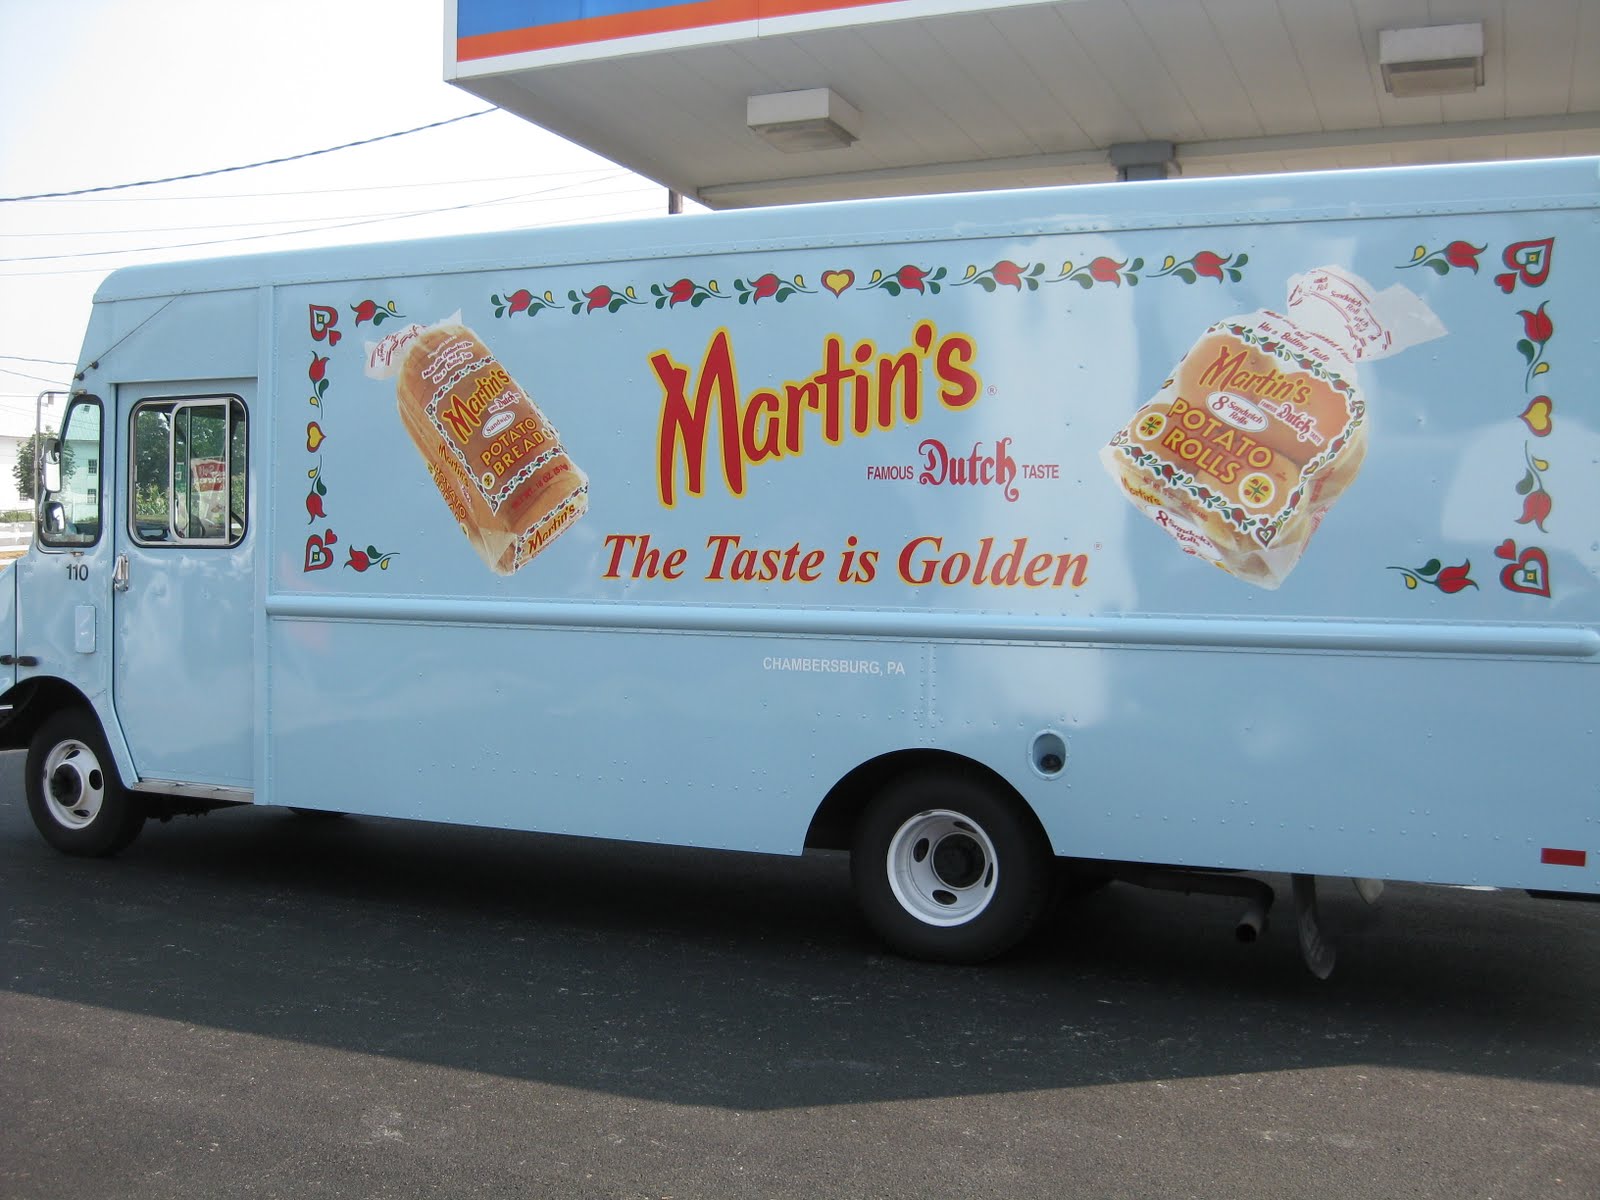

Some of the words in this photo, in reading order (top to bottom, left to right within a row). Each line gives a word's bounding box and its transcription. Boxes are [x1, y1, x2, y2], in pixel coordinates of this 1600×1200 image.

[1198, 345, 1312, 405] Martin's
[442, 369, 511, 445] Martin's
[486, 413, 512, 433] Sandwich
[649, 321, 981, 509] Martin's
[1211, 395, 1230, 411] 8
[1227, 401, 1264, 425] Sandwich
[1228, 411, 1249, 426] Rolls
[1276, 403, 1316, 439] Dutch
[481, 417, 537, 466] POTATO
[492, 430, 545, 477] BREAD
[1161, 425, 1241, 485] ROLLS
[1167, 397, 1274, 470] POTATO
[867, 465, 914, 481] FAMOUS
[917, 436, 1019, 502] Dutch
[1022, 463, 1060, 480] TASTE
[527, 504, 576, 555] Martin's
[67, 564, 89, 581] 110
[602, 534, 688, 581] The
[704, 534, 826, 583] Taste
[837, 535, 879, 584] is
[898, 535, 1089, 588] Golden
[763, 656, 883, 677] CHAMBERSBURG,
[887, 660, 906, 676] PA
